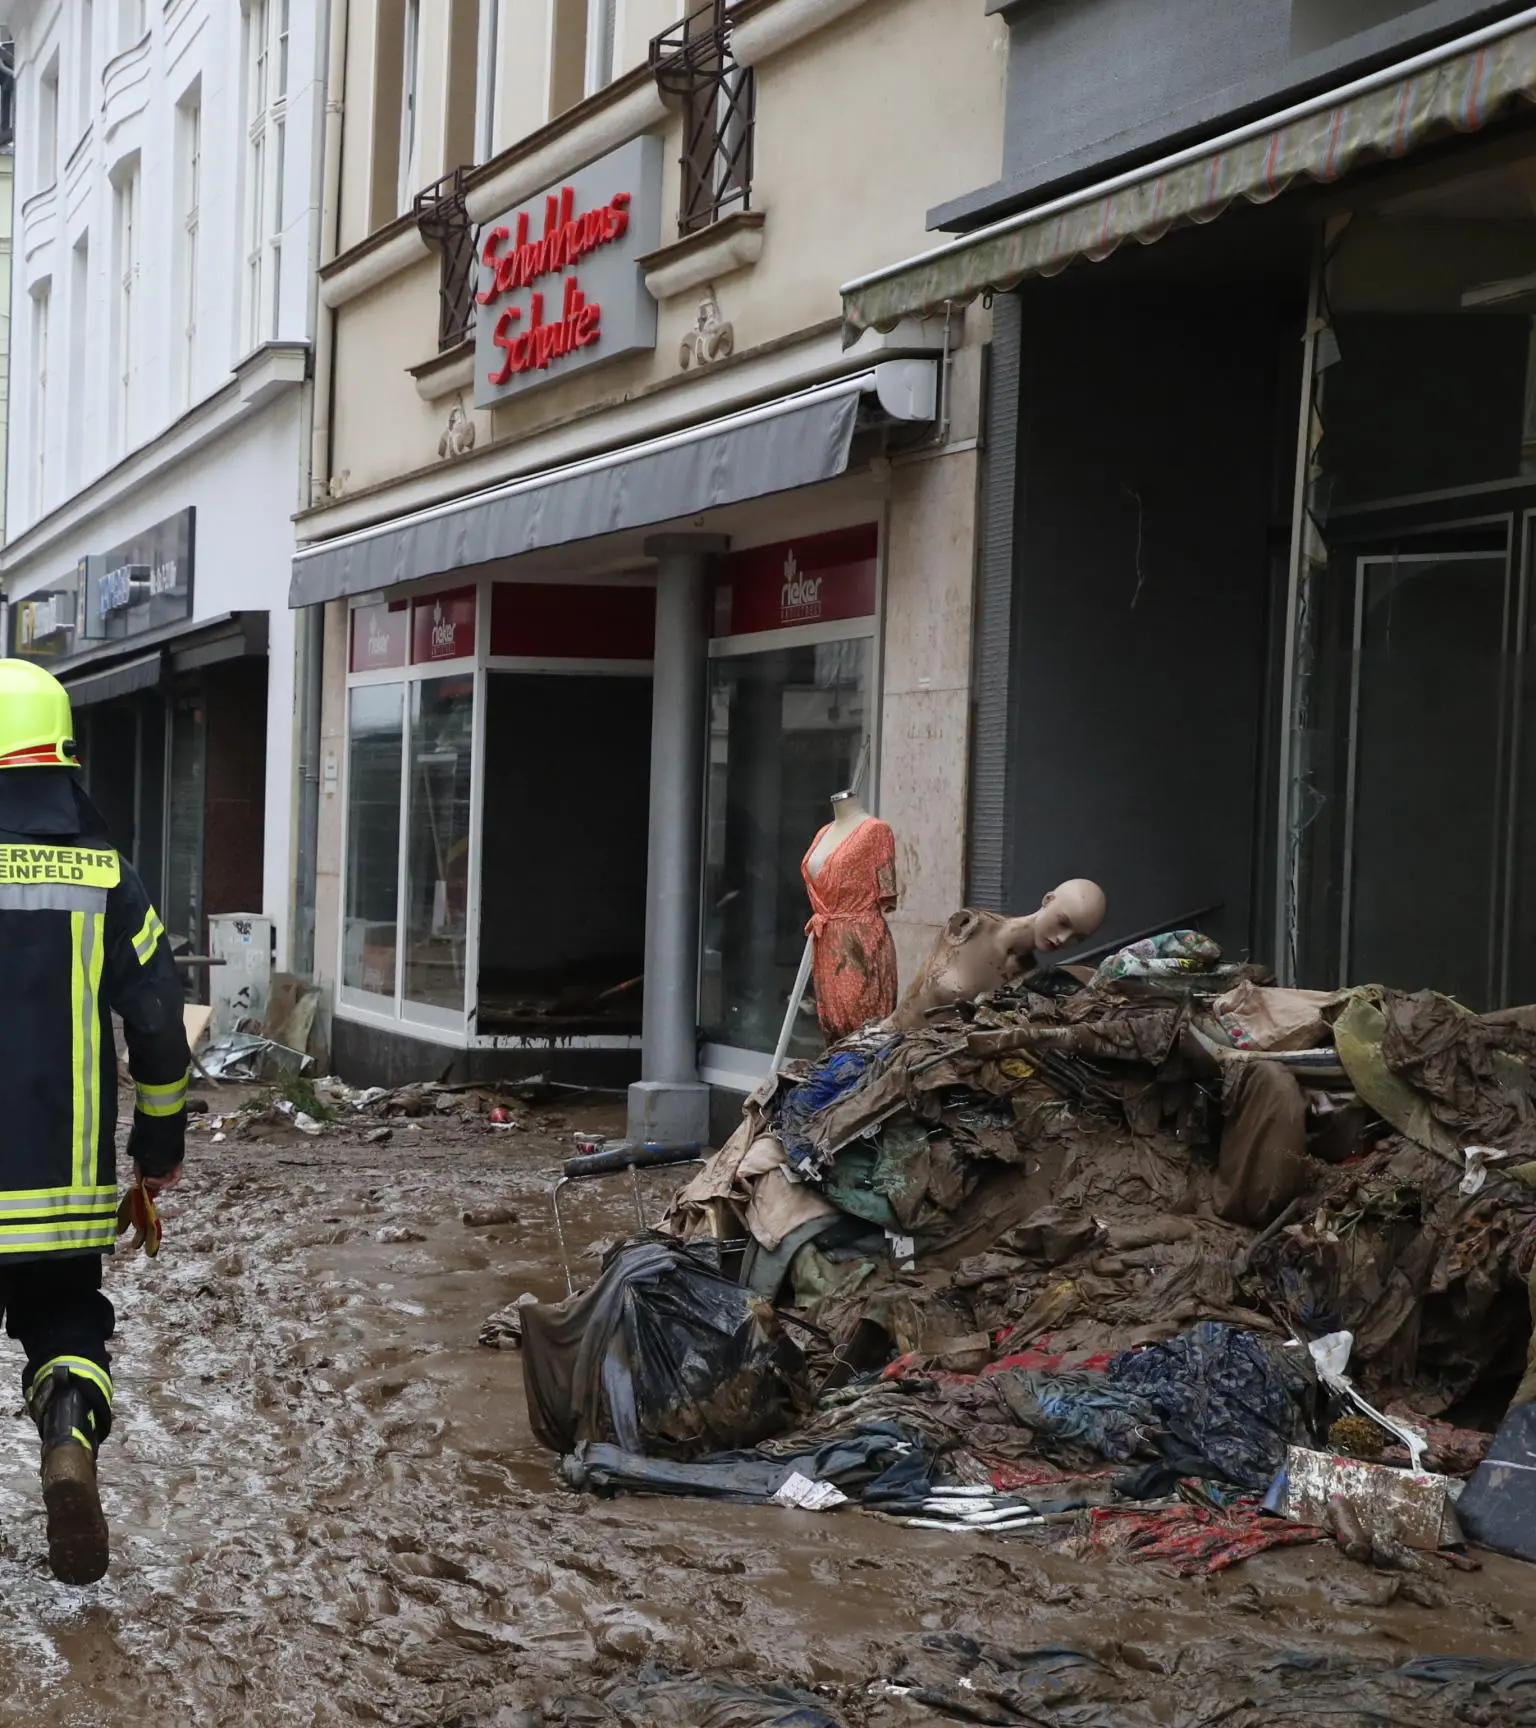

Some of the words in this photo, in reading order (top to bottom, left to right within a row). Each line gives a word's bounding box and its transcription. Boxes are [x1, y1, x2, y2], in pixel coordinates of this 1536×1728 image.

[475, 187, 632, 305] Schuhhaus
[488, 276, 601, 385] Schulte
[781, 571, 822, 606] rieker
